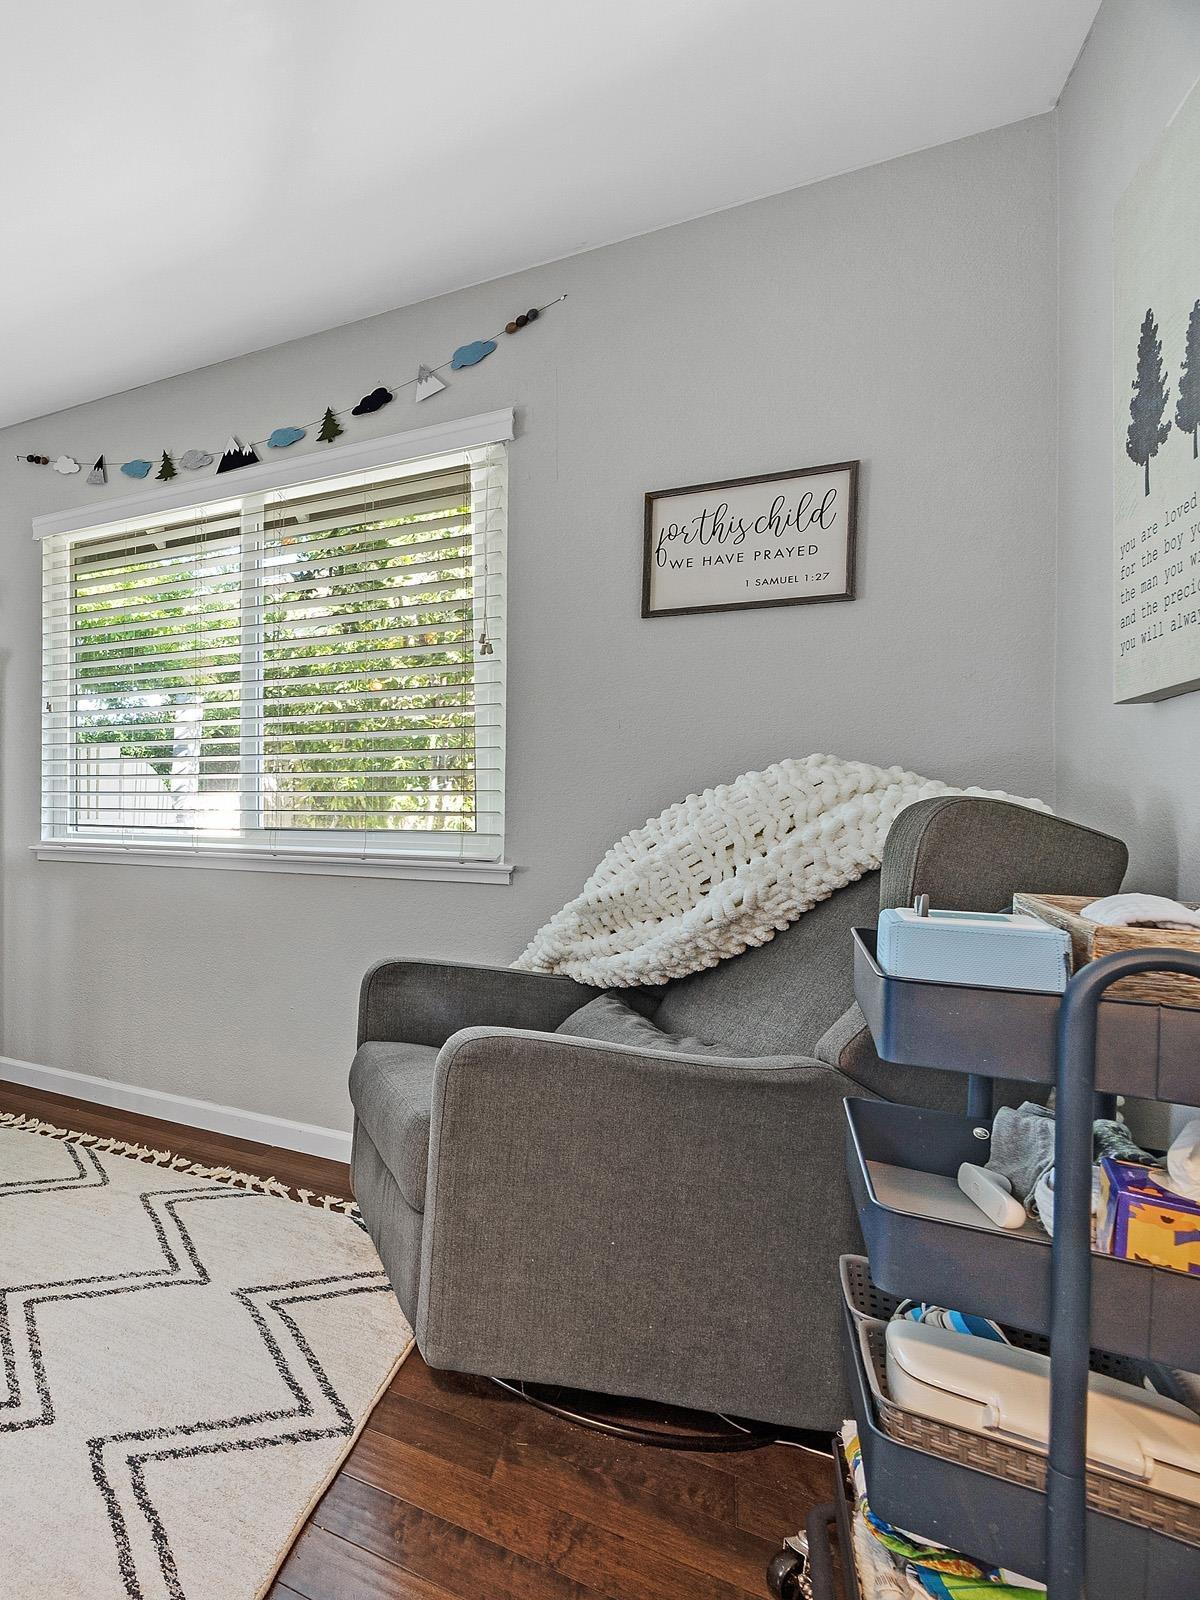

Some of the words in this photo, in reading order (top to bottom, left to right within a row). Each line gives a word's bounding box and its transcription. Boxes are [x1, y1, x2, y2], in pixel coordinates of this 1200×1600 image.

[655, 523, 699, 567] for
[692, 503, 754, 545] this
[754, 488, 837, 538] child
[1120, 537, 1136, 560] you
[1141, 523, 1158, 543] are
[1164, 491, 1198, 527] loved
[669, 557, 694, 569] WE
[702, 552, 745, 567] HAVE
[754, 544, 819, 561] PRAYED
[1120, 562, 1136, 580] for
[1141, 549, 1158, 567] the
[1163, 532, 1184, 554] boy
[745, 579, 749, 587] 1
[755, 575, 799, 587] SAMUEL
[804, 572, 830, 582] 1:27
[1120, 588, 1136, 604] the
[1140, 575, 1158, 593] man
[1164, 560, 1184, 585] you
[1120, 608, 1136, 629] and
[1141, 602, 1158, 619] the
[1120, 637, 1136, 657] you
[1140, 621, 1164, 644] will
